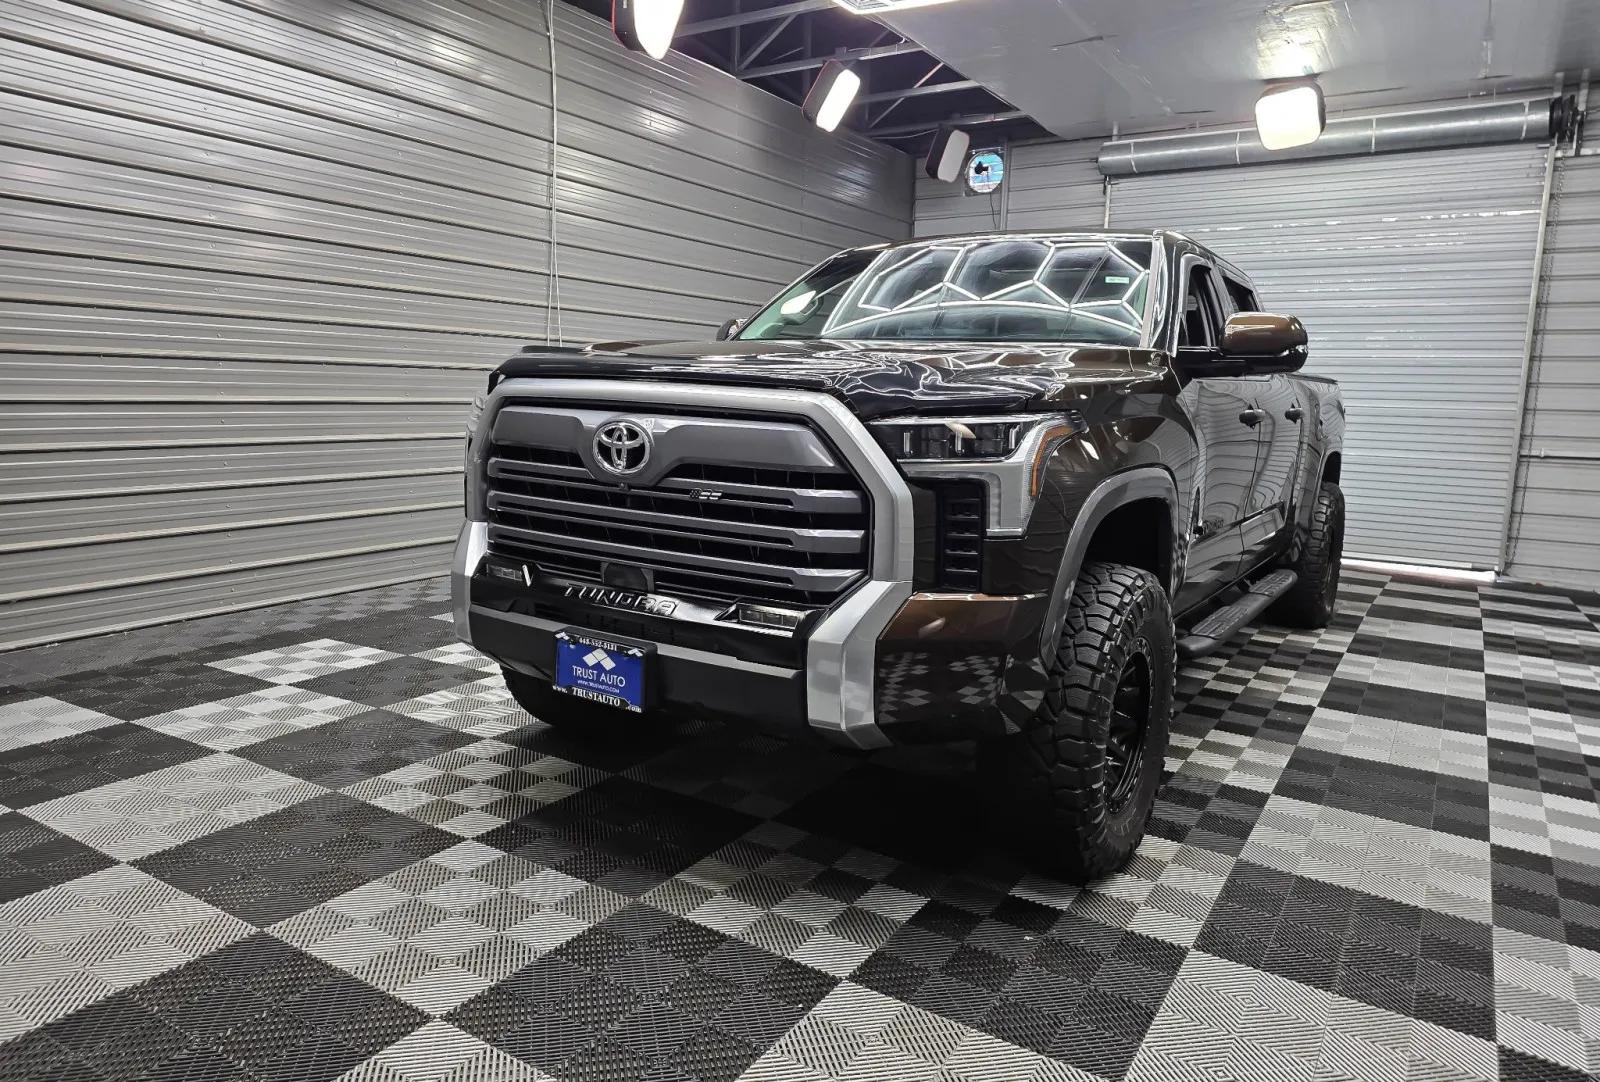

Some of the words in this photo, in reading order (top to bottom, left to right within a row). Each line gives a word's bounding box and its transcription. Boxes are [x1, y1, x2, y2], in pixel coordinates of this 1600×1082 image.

[563, 583, 677, 614] TUNDRA
[572, 665, 598, 681] TRUST
[599, 672, 626, 688] AUTO
[572, 687, 621, 707] TRUSTAUTO
